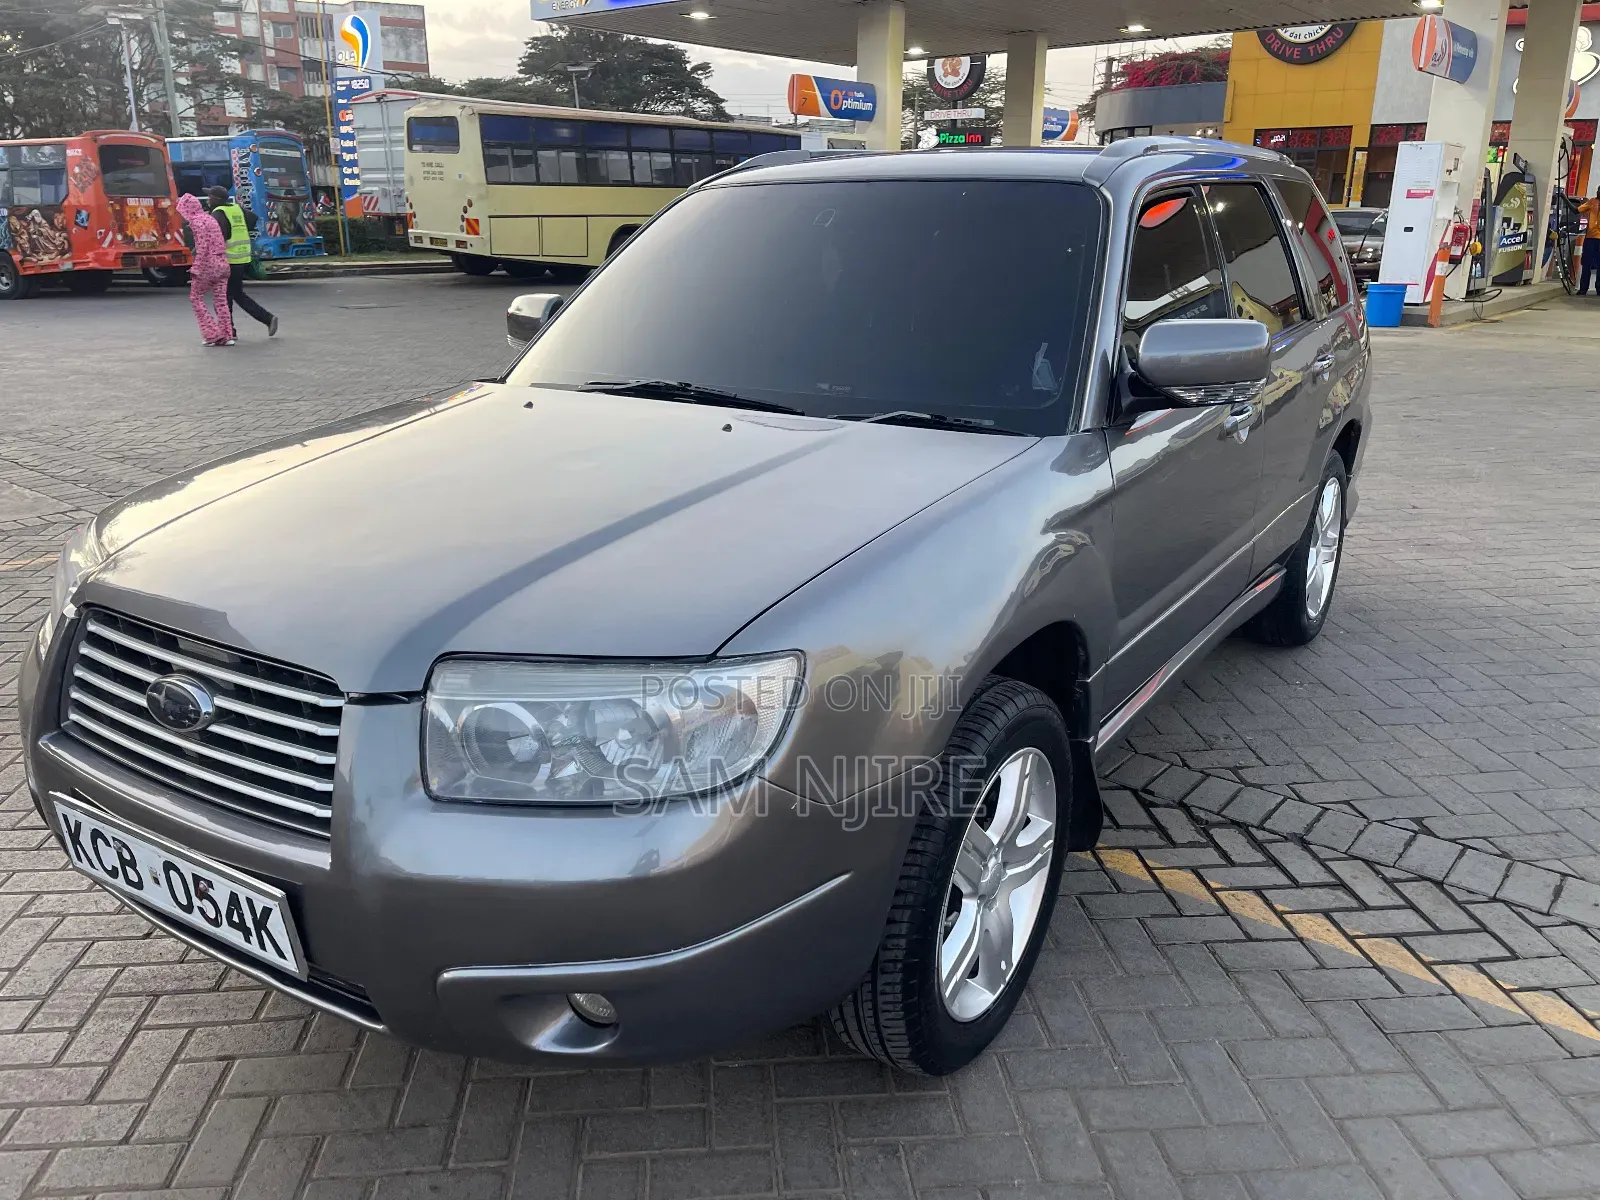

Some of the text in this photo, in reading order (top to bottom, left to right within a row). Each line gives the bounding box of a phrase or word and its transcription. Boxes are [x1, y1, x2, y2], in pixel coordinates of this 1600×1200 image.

[1264, 27, 1344, 59] DRIVE THRU
[337, 50, 356, 61] OLA
[932, 79, 973, 98] DRIVE THRU
[801, 97, 808, 107] 7
[930, 109, 973, 119] DRIVE THRU
[940, 132, 982, 144] Pizza Inn
[1499, 233, 1524, 246] Accel
[1498, 244, 1523, 253] FUSION
[61, 812, 289, 962] KCB 054K
